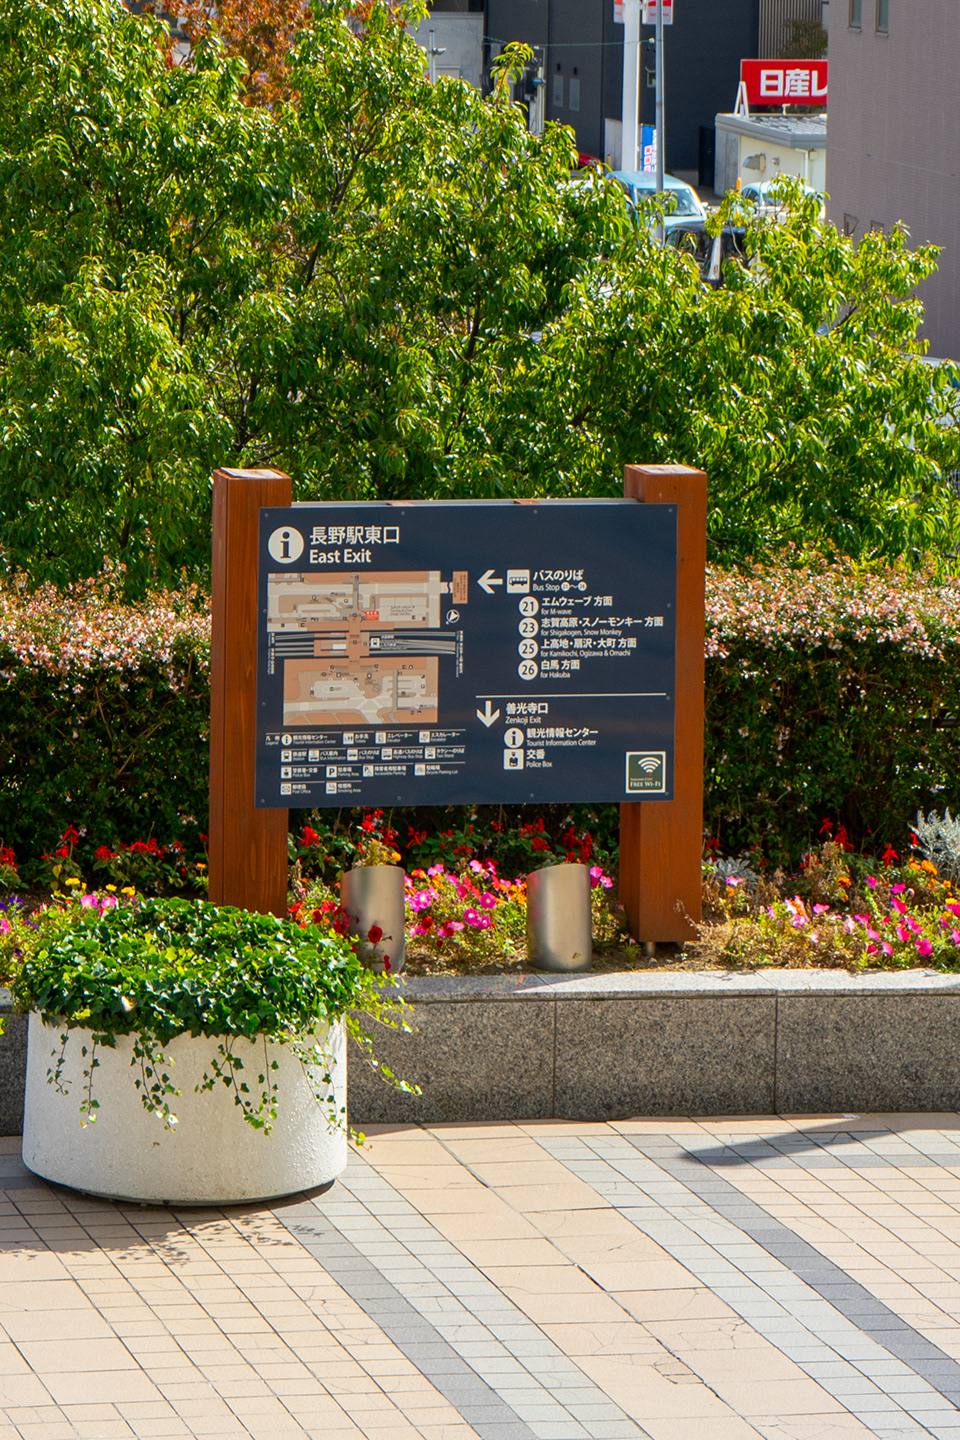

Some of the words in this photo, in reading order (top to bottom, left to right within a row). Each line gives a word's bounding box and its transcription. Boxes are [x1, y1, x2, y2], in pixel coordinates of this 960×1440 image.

[760, 68, 828, 97] 日産レ
[309, 525, 400, 545] 長野駅東口
[309, 549, 340, 564] East
[343, 548, 372, 563] Exit
[533, 569, 584, 581] バスのりば
[533, 583, 545, 591] Bus
[545, 583, 560, 592] Stop
[522, 601, 535, 613] 21
[541, 596, 592, 607] エムウェーブ
[593, 596, 613, 607] 方面
[522, 622, 535, 633] 23
[644, 616, 664, 627] 方面
[600, 628, 622, 637] Monkey
[522, 643, 535, 655] 25
[617, 637, 637, 649] 方面
[579, 650, 603, 658] Ogizawa
[521, 664, 535, 676] 26
[540, 660, 559, 671] 白馬
[560, 659, 580, 670] 方面
[549, 671, 571, 679] Hakuba
[505, 702, 549, 714] 善光寺口
[505, 716, 528, 725] Zenkoji
[529, 715, 541, 724] Exit
[526, 727, 599, 738] 観光情報センター
[526, 739, 545, 747] Tourist
[545, 739, 577, 747] Information
[578, 738, 596, 746] Center
[526, 749, 545, 760] 交番
[526, 760, 541, 768] Police
[542, 760, 553, 768] Box
